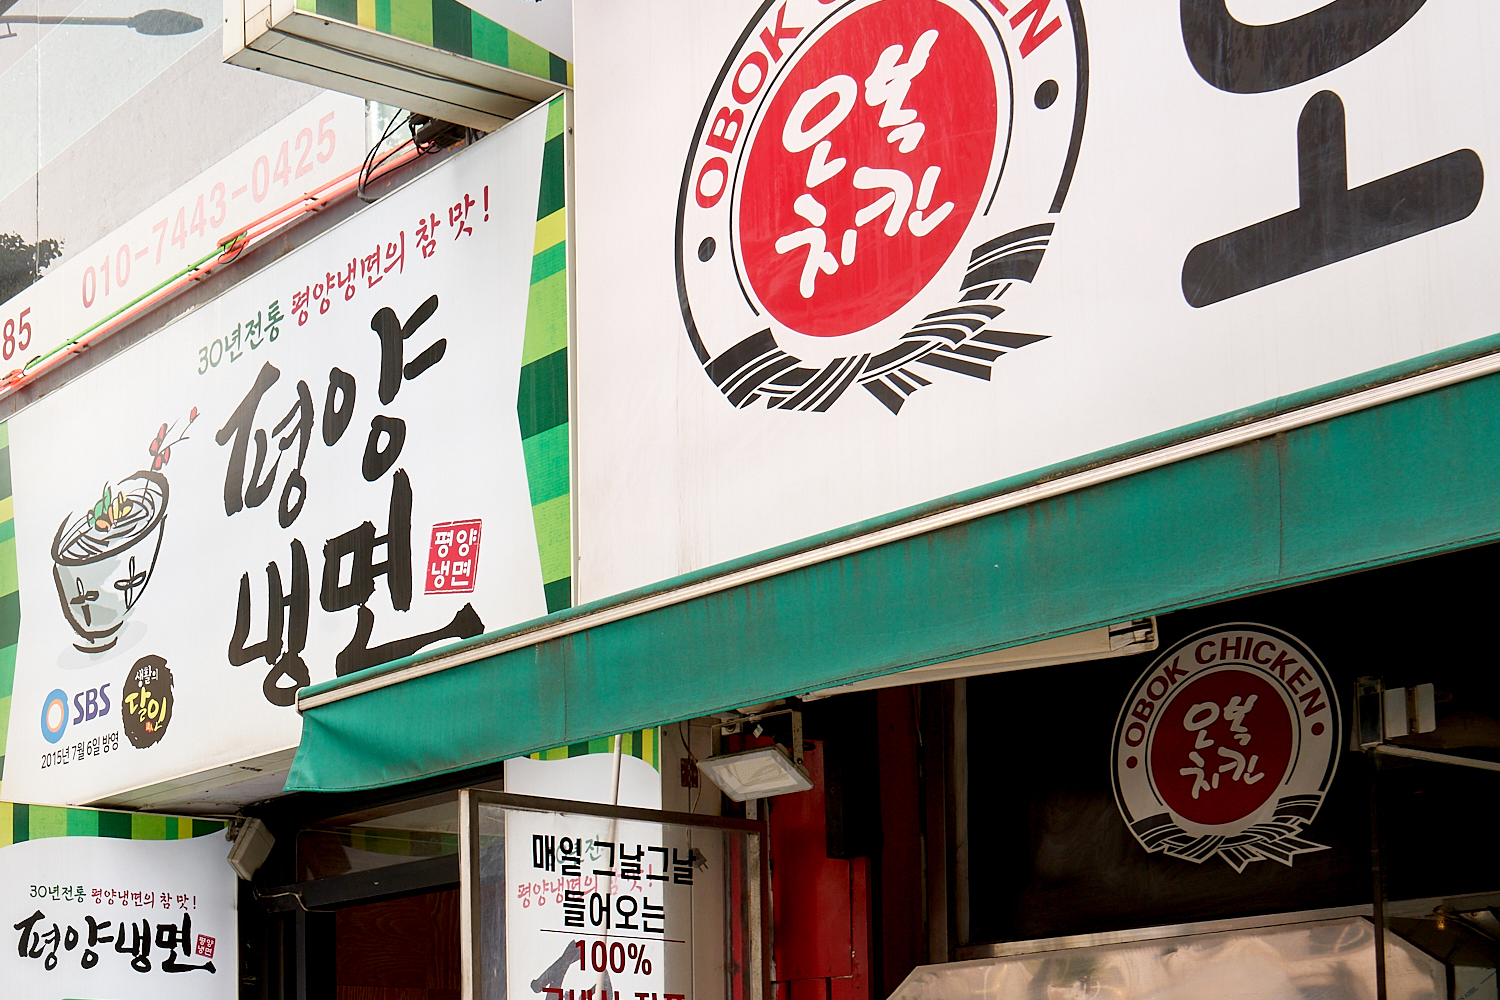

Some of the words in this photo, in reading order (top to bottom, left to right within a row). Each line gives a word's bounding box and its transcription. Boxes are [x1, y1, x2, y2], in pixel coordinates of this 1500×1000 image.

[695, 2, 805, 208] OBOK
[81, 110, 338, 311] 010-7443-0425
[776, 165, 955, 299] 치킨
[198, 299, 286, 377] 30년전통
[290, 245, 407, 328] 평양냉면의
[415, 212, 441, 259] 참
[447, 186, 492, 243] 맛!
[214, 293, 447, 528] 평양
[433, 525, 481, 562] 평양
[227, 468, 486, 707] 냉면
[430, 559, 474, 593] 냉면
[134, 664, 159, 688] 생활의
[1125, 655, 1190, 748] OBOK
[1194, 636, 1327, 718] CHICKEN
[72, 681, 112, 728] SBS
[124, 686, 167, 732] 달인
[41, 742, 71, 771] 2015년
[71, 738, 86, 763] 7월
[86, 735, 101, 758] 6일
[102, 731, 119, 754] 방영
[1179, 747, 1265, 800] 치킨
[532, 833, 583, 877] 매일
[593, 840, 695, 886] 그날그날
[29, 885, 87, 903] 30년전통
[91, 887, 155, 908] 평양냉면의
[160, 891, 173, 909] 참
[176, 893, 198, 911] 맛!
[562, 889, 666, 934] 들어오는
[13, 909, 217, 974] 평양냉면
[197, 944, 214, 957] 냉면
[198, 934, 216, 947] 평양
[576, 939, 653, 976] 100%
